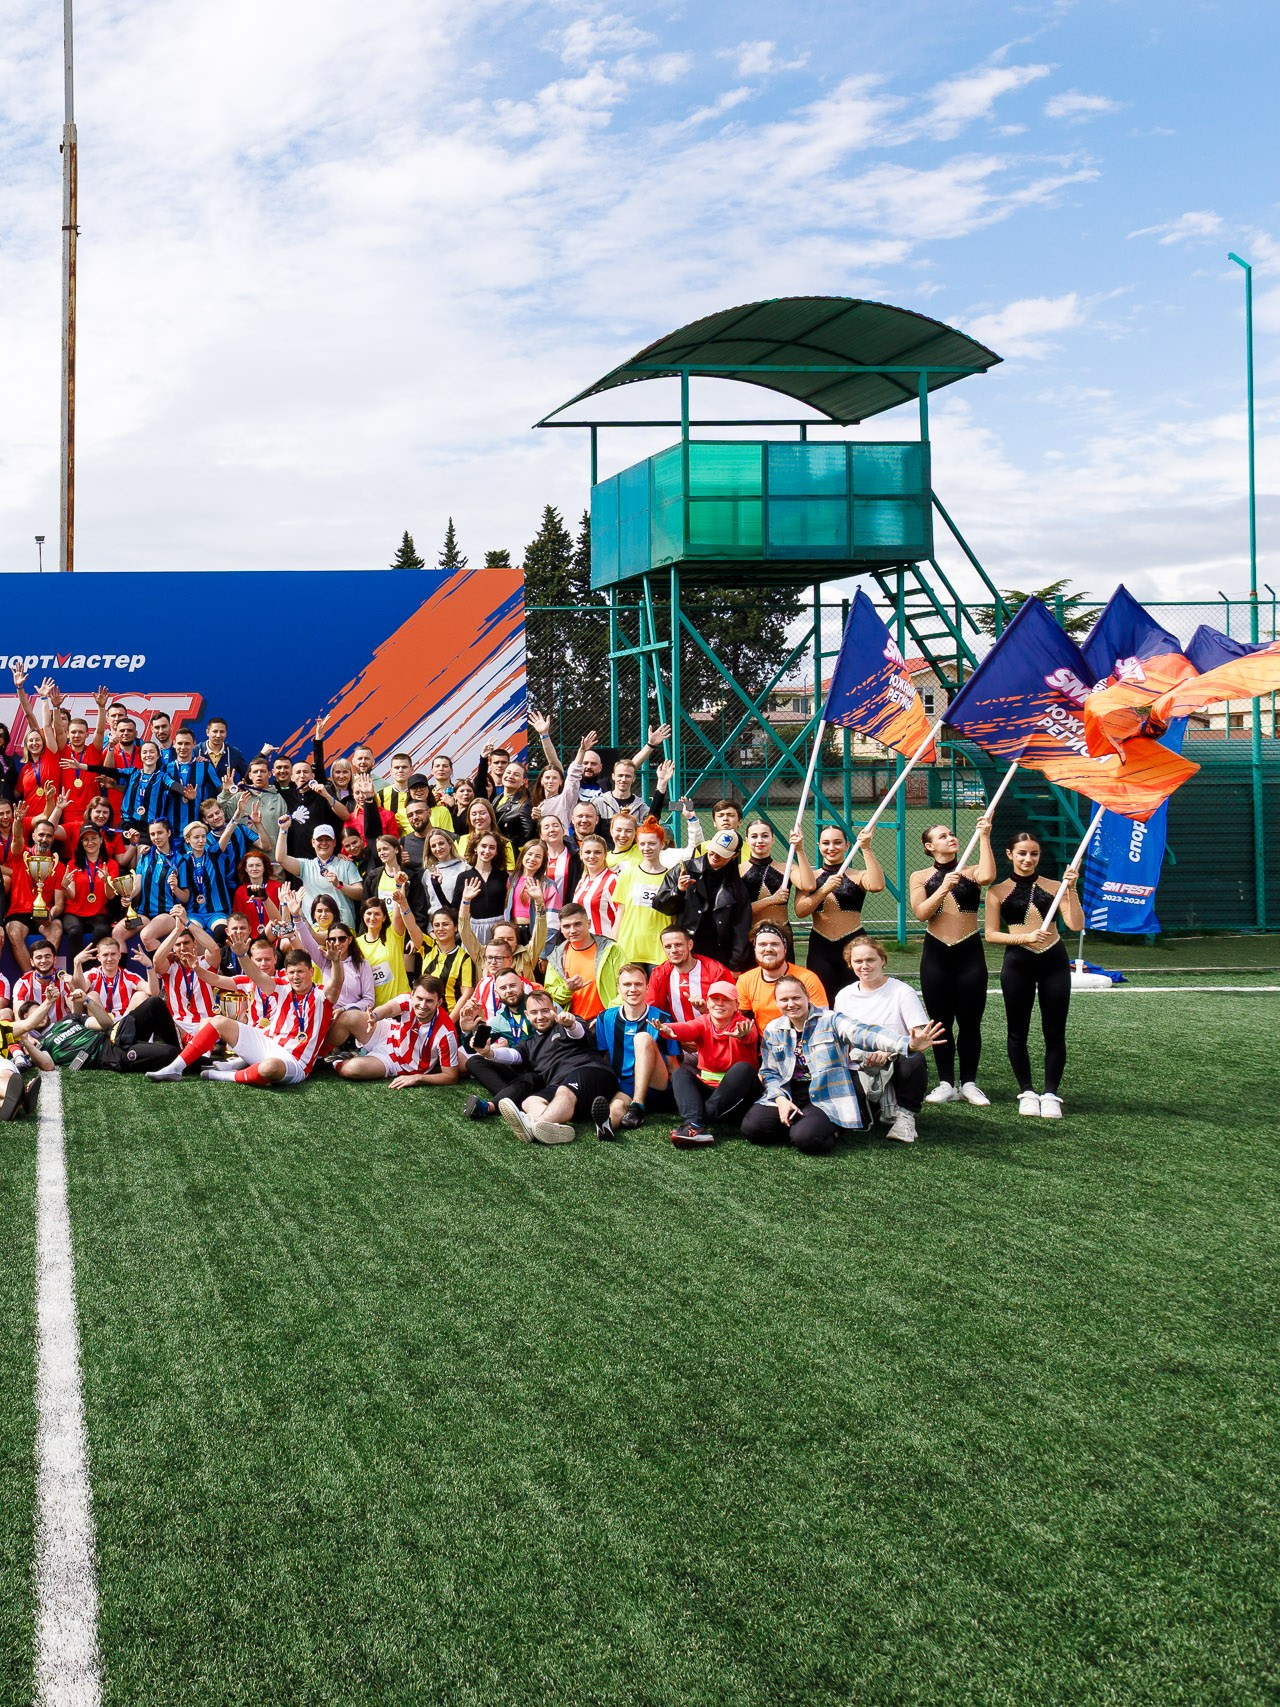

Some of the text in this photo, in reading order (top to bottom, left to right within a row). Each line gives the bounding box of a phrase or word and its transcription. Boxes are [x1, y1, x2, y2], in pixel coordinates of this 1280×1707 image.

[1101, 881, 1155, 897] SM FEST
[642, 891, 658, 901] 32
[1101, 894, 1147, 905] 2023-2024
[372, 971, 385, 980] 28
